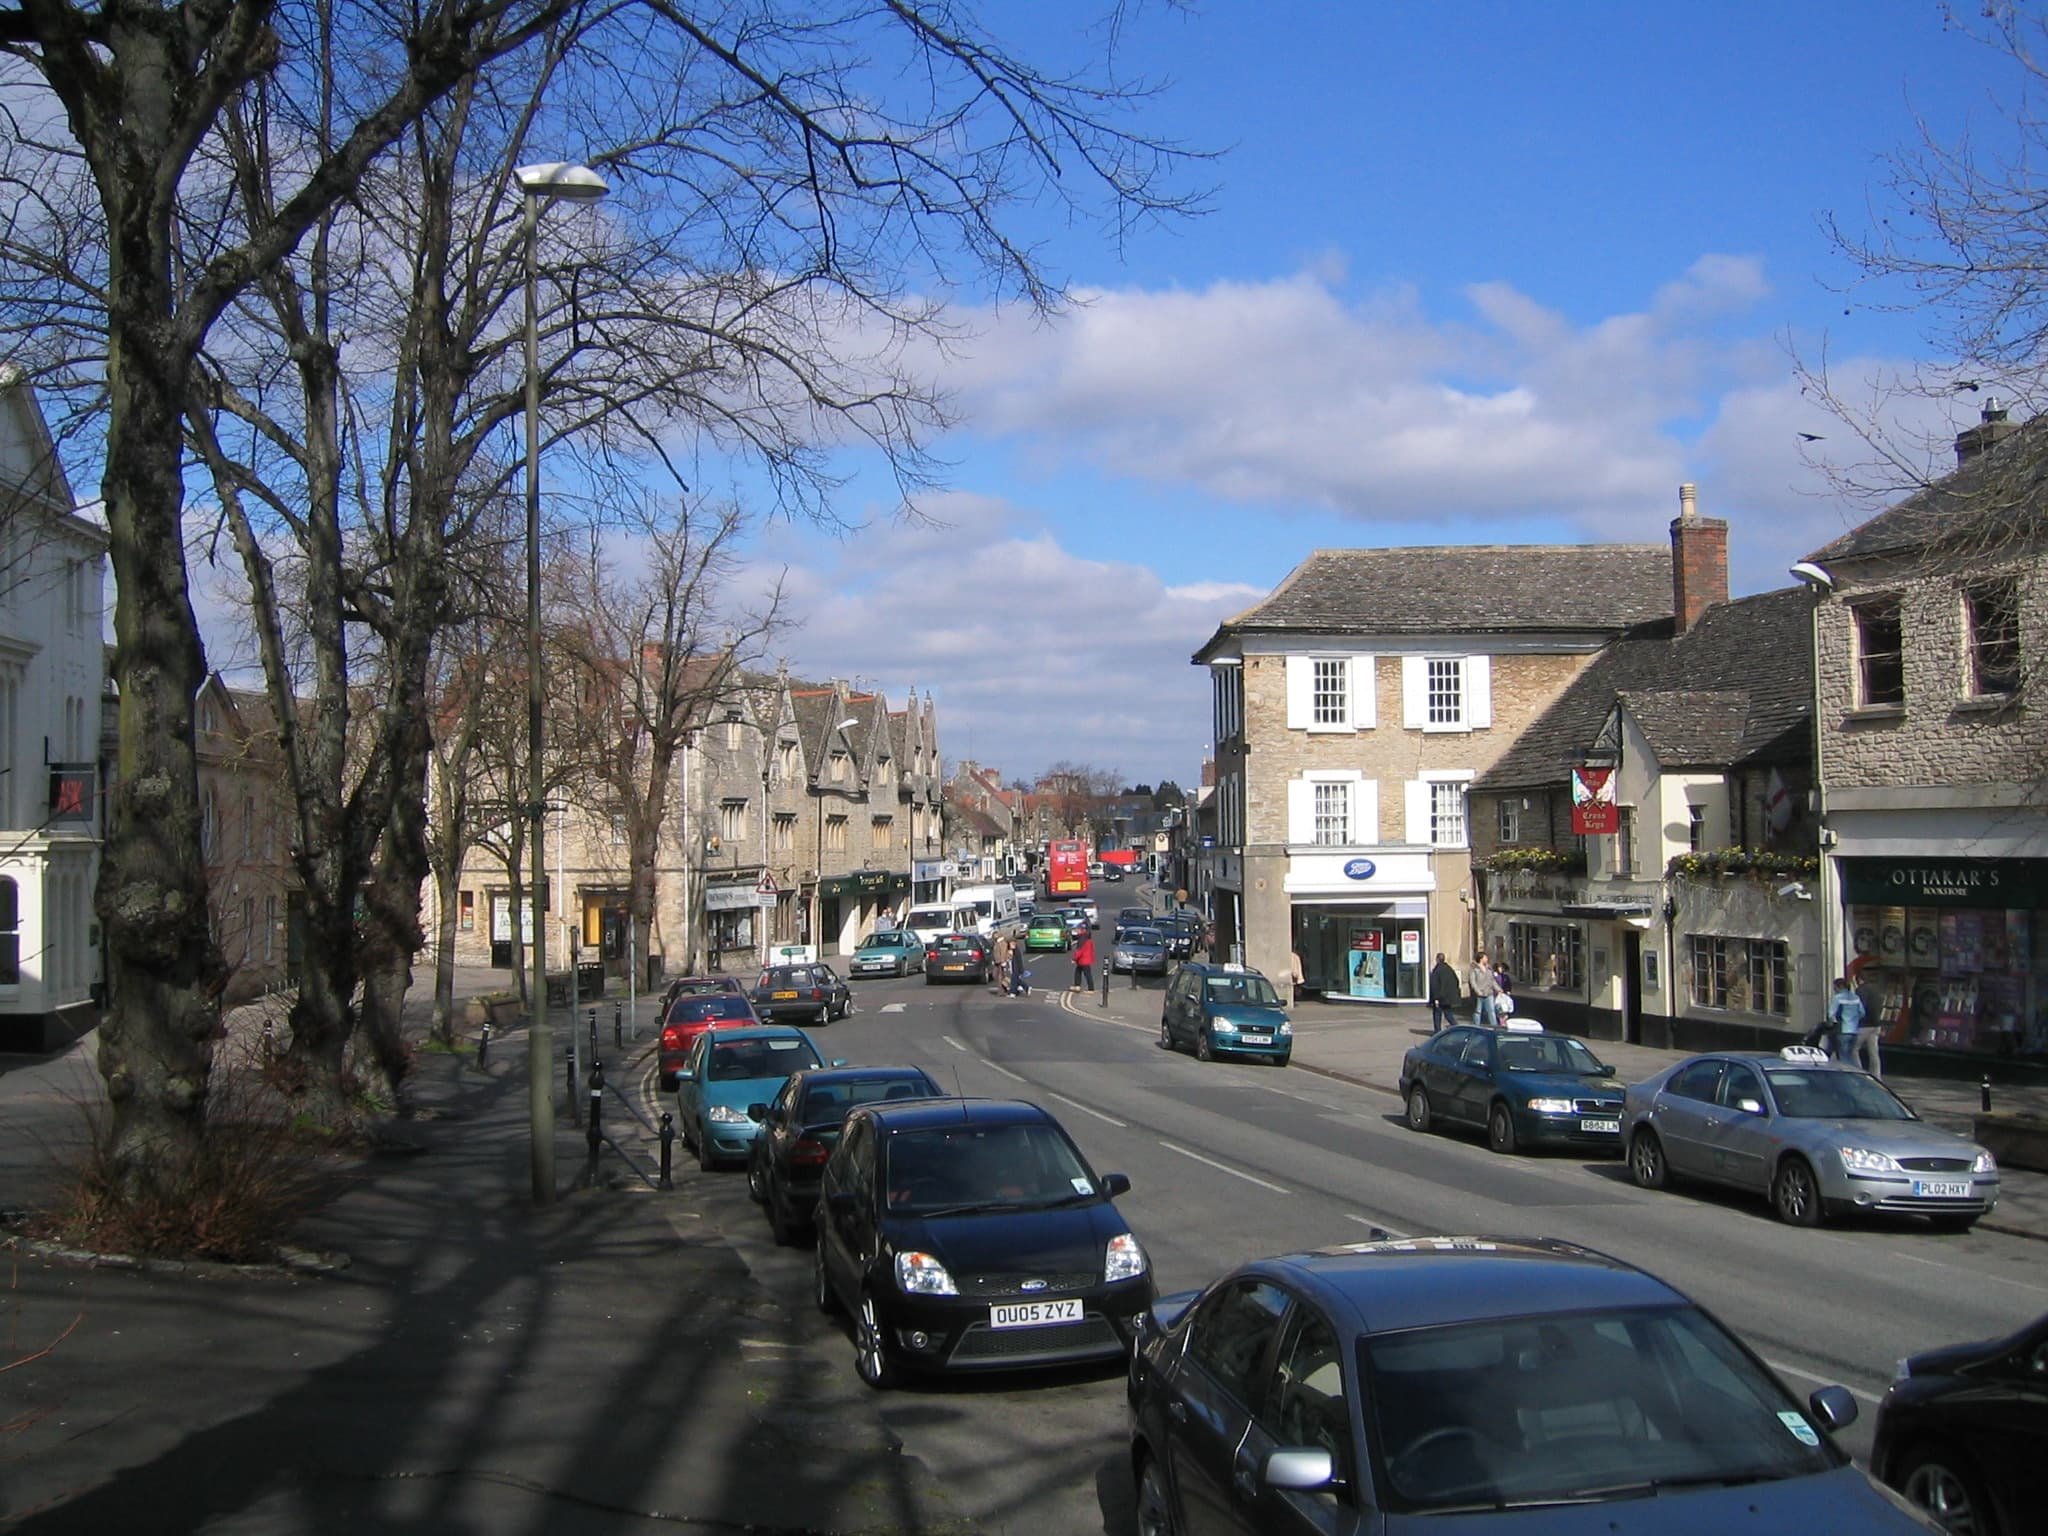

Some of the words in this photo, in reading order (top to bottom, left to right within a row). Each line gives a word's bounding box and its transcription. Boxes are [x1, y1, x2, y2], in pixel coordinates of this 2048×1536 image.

[1582, 811, 1607, 820] Cross
[1585, 820, 1605, 829] Keys
[1892, 869, 2000, 886] OTTAKAR'S
[1787, 1047, 1824, 1056] TAXI
[1921, 1183, 1948, 1195] PL02
[1948, 1184, 1967, 1196] HXY
[1044, 1301, 1075, 1320] ZYZ
